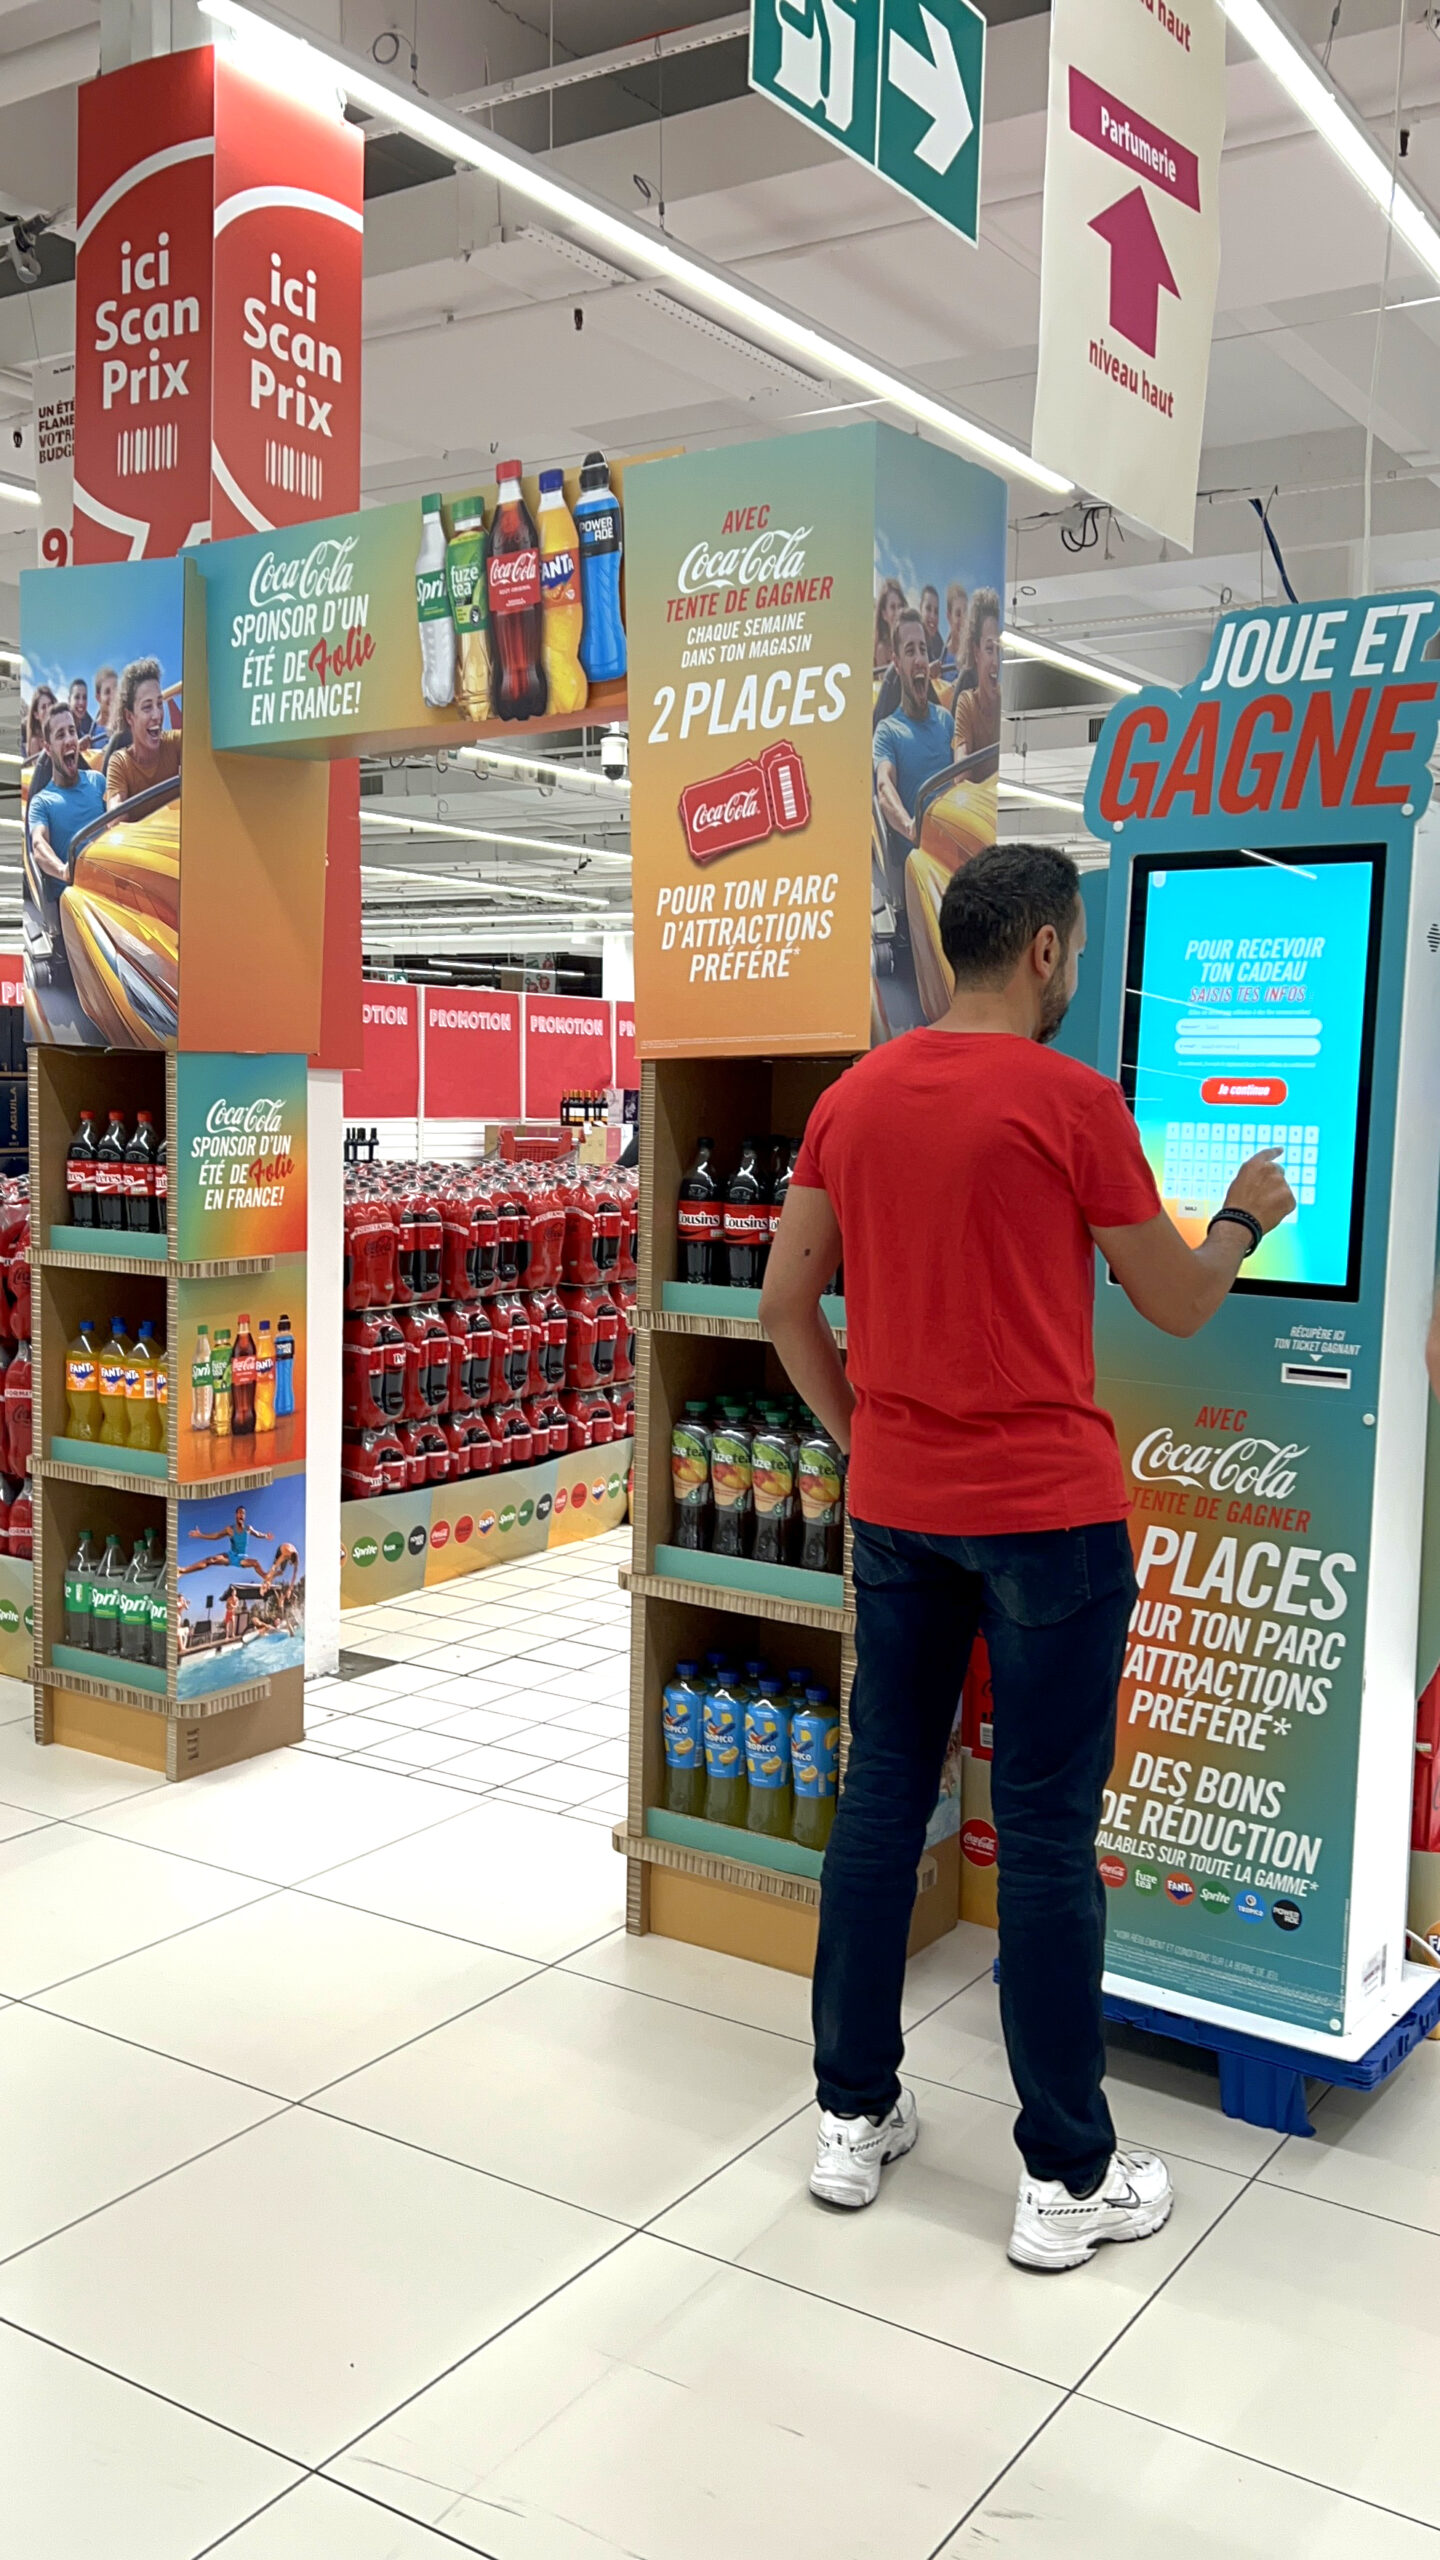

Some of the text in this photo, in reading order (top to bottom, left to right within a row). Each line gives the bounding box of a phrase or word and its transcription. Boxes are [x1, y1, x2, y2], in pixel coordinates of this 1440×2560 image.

[1100, 105, 1176, 183] Parfumerie
[121, 232, 169, 295] ici
[270, 252, 317, 324] ici
[95, 296, 200, 351] Scan
[242, 297, 342, 384] Scan
[102, 347, 190, 410] Prix
[1088, 338, 1174, 419] niveau haut
[38, 404, 55, 419] UN
[250, 358, 333, 438] Prix
[579, 516, 613, 533] POWER
[721, 504, 771, 535] AVEC
[249, 535, 360, 608] Coca-Cola
[450, 566, 479, 583] fuze
[490, 551, 537, 587] Coca-Cola
[541, 553, 575, 581] ANTA
[677, 525, 814, 594] Coca-Cola
[416, 572, 447, 606] Spri
[452, 581, 472, 598] tea
[666, 575, 835, 623] TENTE DE GAGNER
[230, 594, 369, 648] SPONSOR D'UN
[686, 611, 806, 646] CHAQUE SEMAINE
[242, 624, 376, 689] ÉTÉ DE Folie
[681, 633, 813, 669] DANS TON MAGASIN
[1201, 601, 1435, 692] JOUE ET
[250, 681, 362, 726] EN FRANCE!
[647, 662, 852, 745] 2 PLACES
[1099, 682, 1439, 822] GAGNE
[691, 787, 760, 833] Coca-Cola
[656, 873, 839, 916] POUR TON PARC
[661, 909, 835, 951] D'ATTRACTIONS
[1184, 937, 1326, 961] POUR RECEVOIR
[1200, 960, 1308, 983] TON CADEAU
[1189, 986, 1306, 1003] SAISIS TES INFOS
[429, 1008, 512, 1032] PROMOTION
[530, 1014, 604, 1037] PROMOTION
[1230, 1084, 1271, 1097] continue
[206, 1098, 287, 1133] Coca-Cola
[190, 1135, 292, 1158] SPONSOR D'UN
[198, 1159, 225, 1186] ÉTÉ
[229, 1163, 250, 1185] DE
[248, 1153, 295, 1188] Folie
[204, 1186, 285, 1210] EN FRANCE!
[679, 1211, 720, 1227] ousins
[1274, 1337, 1362, 1356] TON TICKET GAGNANT
[1195, 1405, 1248, 1433] AVEC
[1131, 1427, 1311, 1500] Coca-Cola
[1131, 1486, 1312, 1533] TENTE DE GAGNER
[353, 1545, 378, 1559] Sprite
[1135, 1525, 1357, 1621] PLACES
[1128, 1600, 1346, 1671] OUR TON PARC
[1128, 1751, 1286, 1819] DES BONS
[1138, 1797, 1323, 1875] RÉDUCTION
[1135, 1869, 1158, 1884] fuze
[1157, 1845, 1187, 1869] SUR
[1189, 1852, 1234, 1880] TOUTE
[1234, 1863, 1251, 1884] LA
[1167, 1880, 1193, 1893] FANTA
[1200, 1888, 1231, 1904] Sprite
